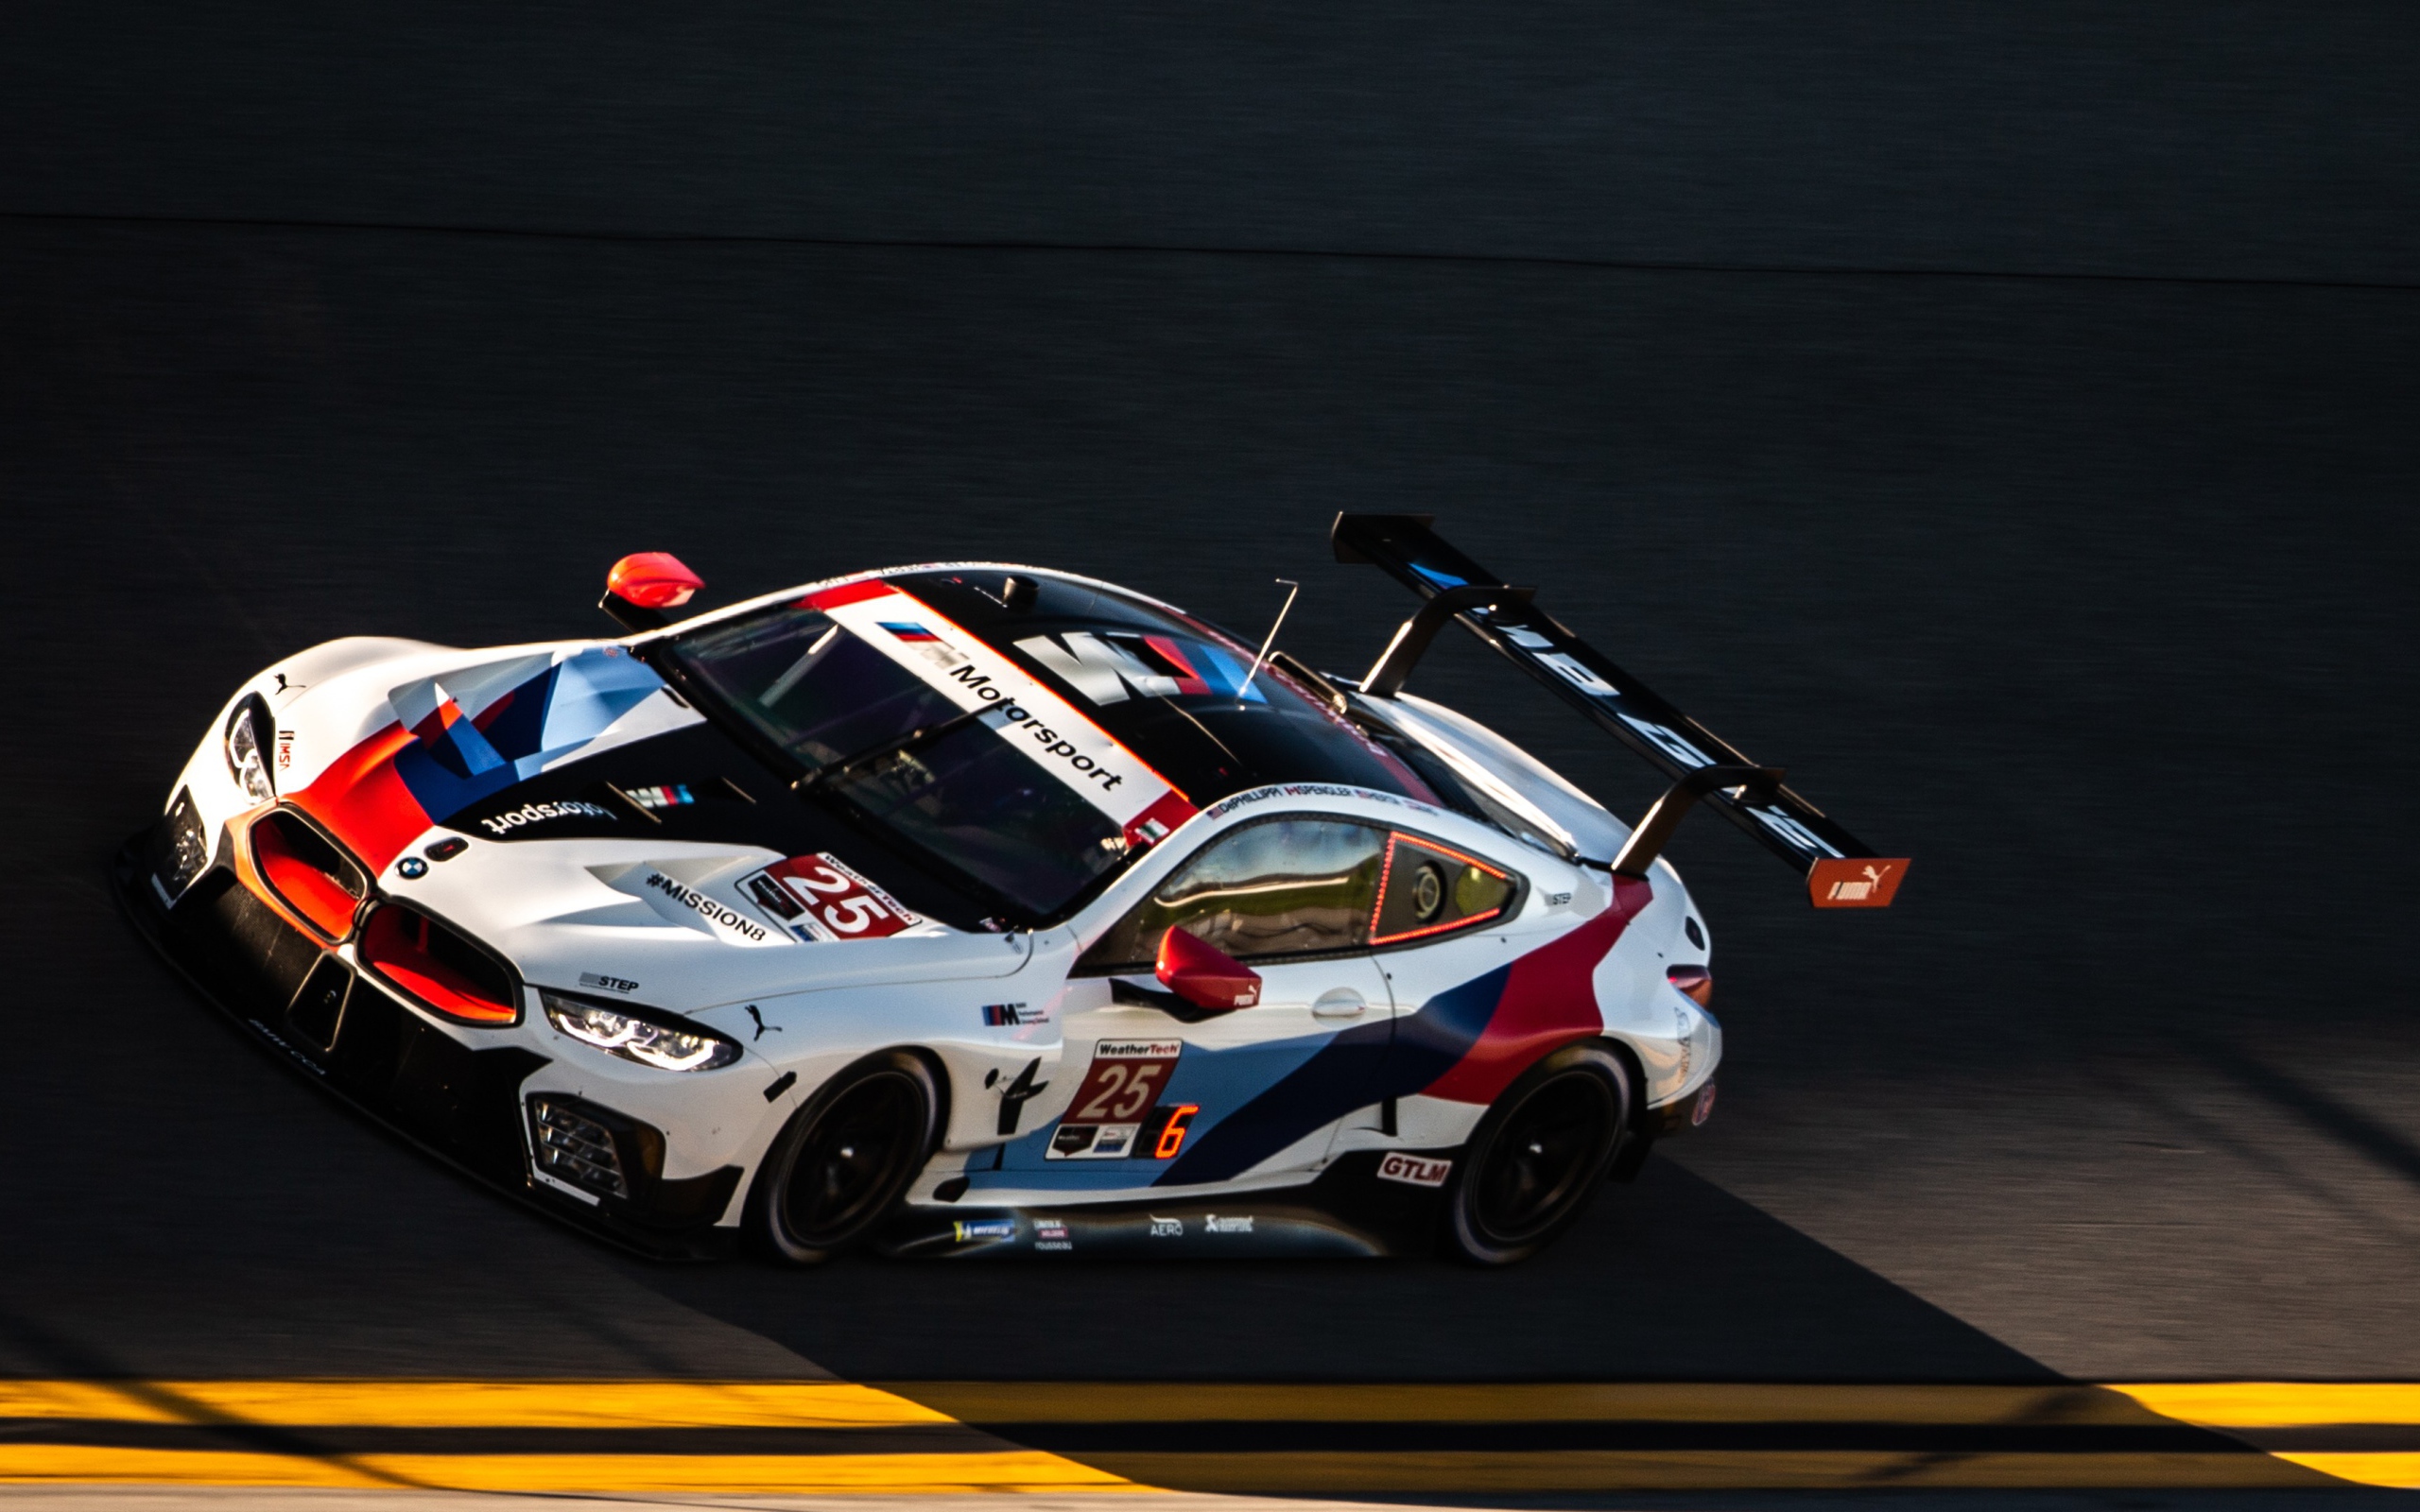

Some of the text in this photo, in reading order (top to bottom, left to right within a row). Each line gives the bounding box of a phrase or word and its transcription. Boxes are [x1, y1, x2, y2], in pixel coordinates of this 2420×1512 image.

[949, 664, 1123, 792] Motorsport
[646, 872, 767, 942] #MISSION8
[782, 866, 890, 934] 25
[598, 975, 640, 992] STEP
[1099, 1043, 1179, 1055] WeatherTech
[1076, 1064, 1163, 1119] 25
[1154, 1104, 1199, 1160] 6
[1384, 1156, 1448, 1182] GTLM
[1150, 1223, 1184, 1237] AERO
